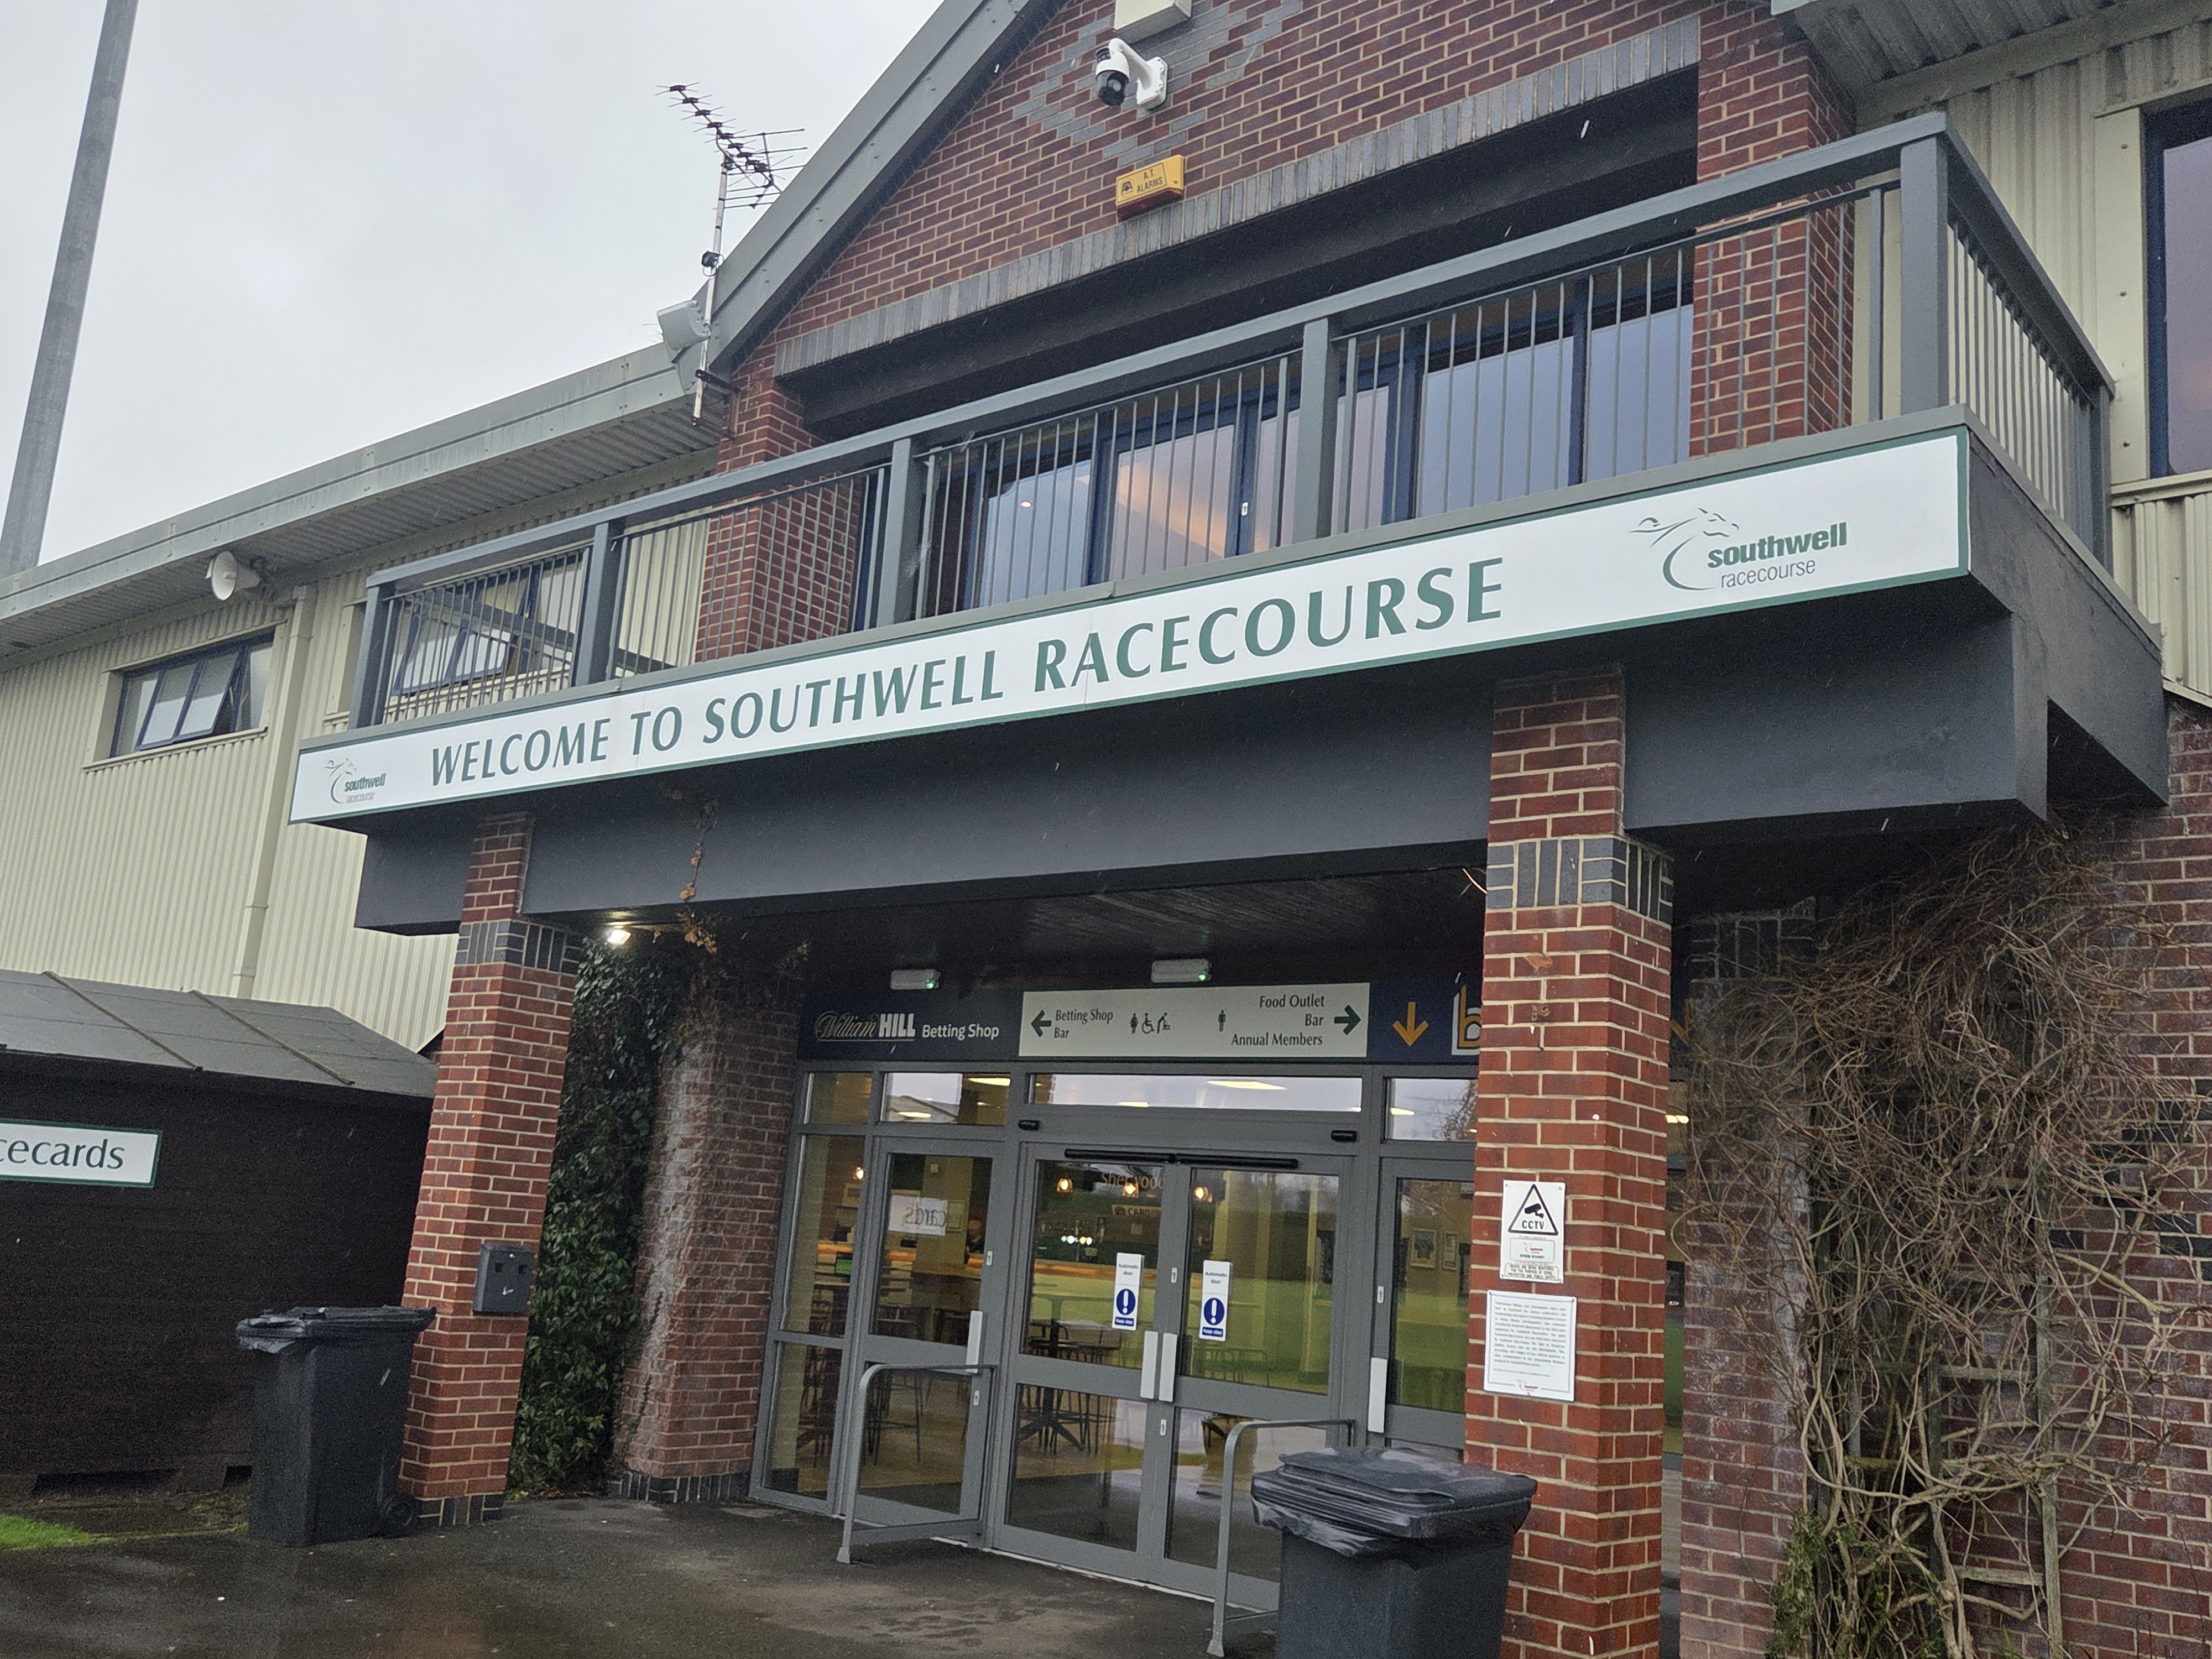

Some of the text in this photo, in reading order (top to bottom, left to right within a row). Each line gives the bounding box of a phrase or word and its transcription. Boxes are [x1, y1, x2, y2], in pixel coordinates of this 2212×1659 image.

[1136, 176, 1163, 194] ALARMS
[1707, 521, 1848, 568] southwell
[1720, 559, 1816, 588] racecourse
[431, 557, 1504, 786] WELCOME TO SOUTHWELL RACECOURSE
[344, 773, 387, 792] southwell
[345, 791, 375, 804] racecourse
[1259, 995, 1325, 1008] Food Outlet
[1055, 1008, 1114, 1025] Betting Shop
[1305, 1014, 1324, 1027] Bar
[814, 1010, 1000, 1041] William HILL Betting Shop
[1054, 1027, 1070, 1039] Bar
[1231, 1032, 1323, 1047] Annual Members
[1522, 1219, 1545, 1230] CCTV
